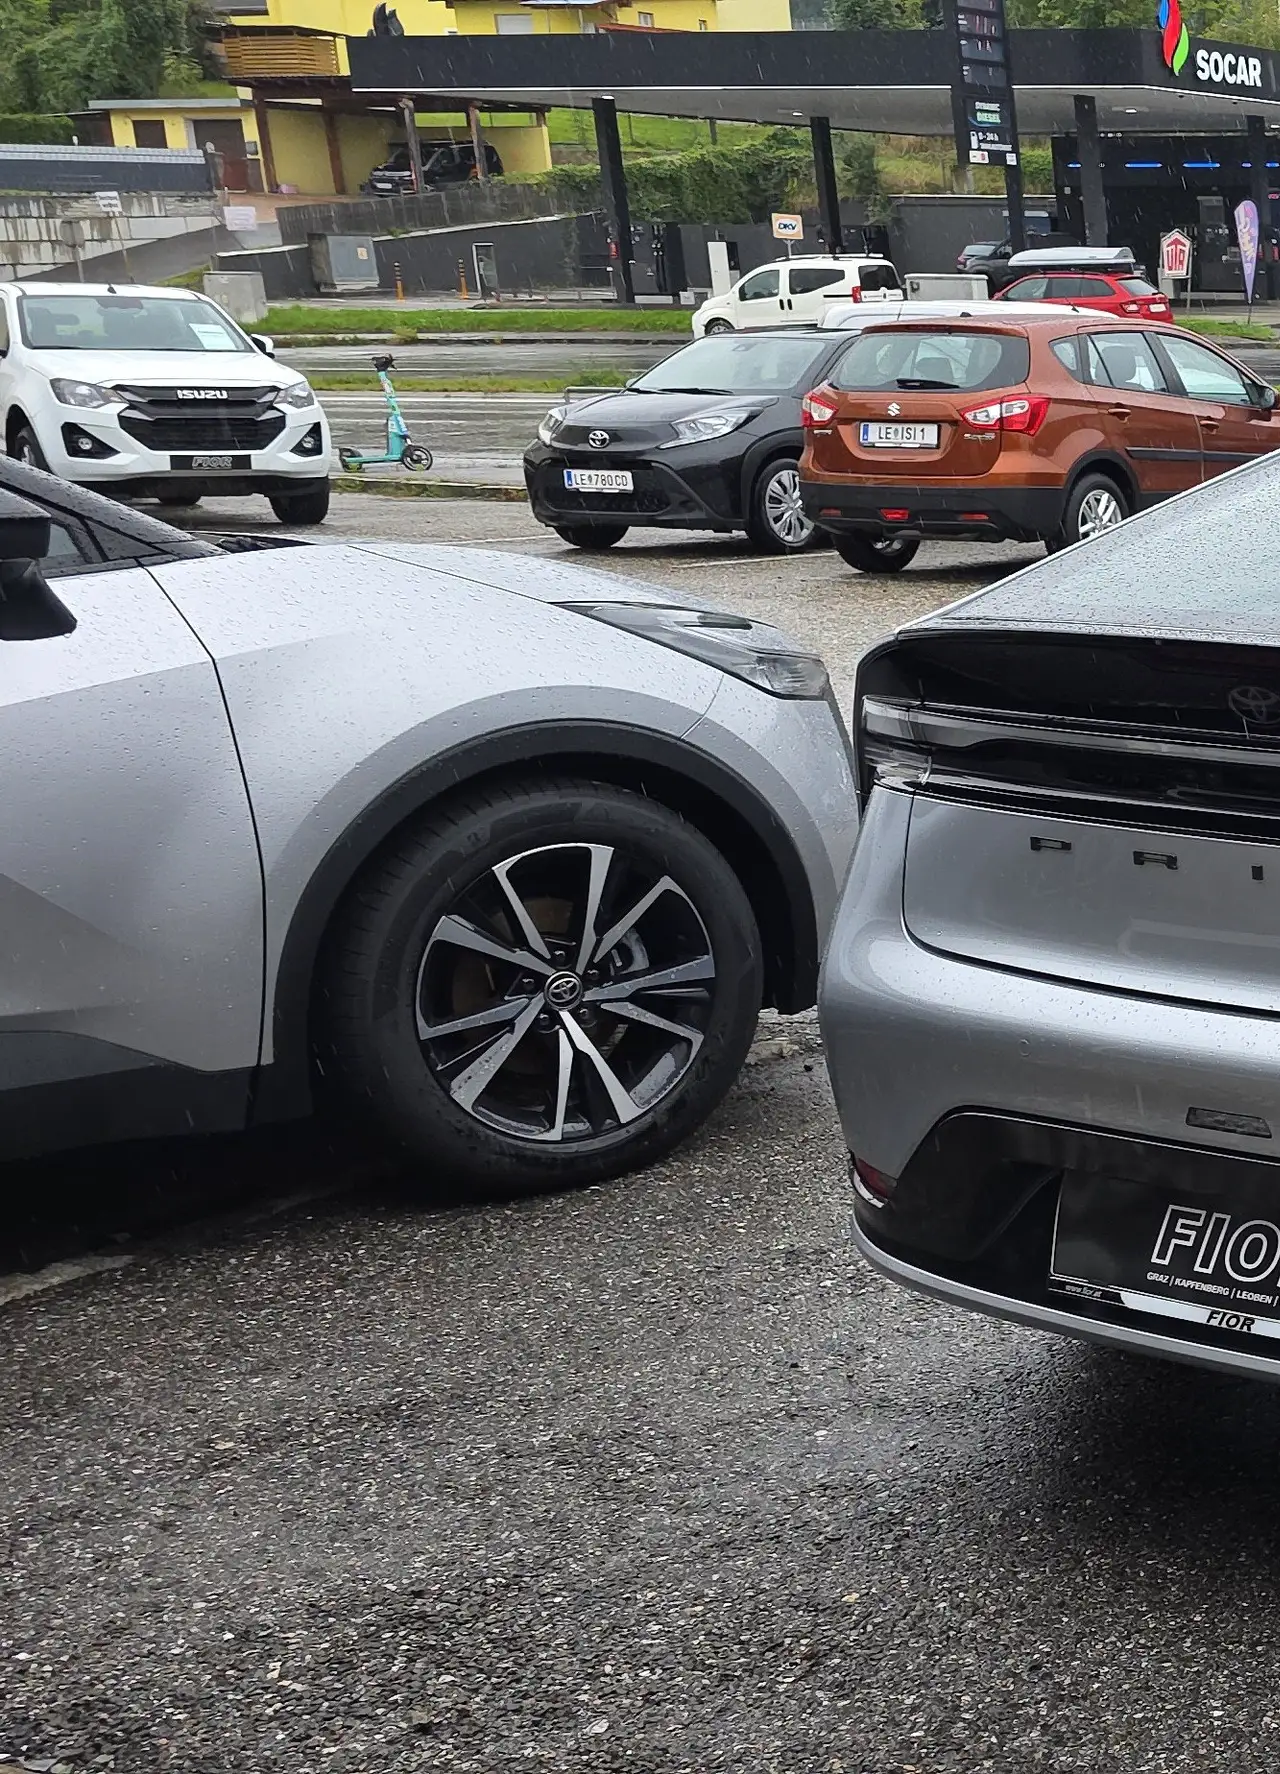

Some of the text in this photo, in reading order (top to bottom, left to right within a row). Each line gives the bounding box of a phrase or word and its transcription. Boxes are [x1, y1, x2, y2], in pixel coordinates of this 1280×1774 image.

[1196, 49, 1262, 87] SOCAR
[778, 222, 797, 230] DKV
[176, 389, 228, 399] ISUZU
[878, 427, 892, 440] LE
[900, 428, 917, 441] ISI
[191, 456, 233, 468] FIOR
[574, 473, 587, 486] LE
[1146, 1271, 1170, 1284] GRAZ
[1174, 1277, 1230, 1296] KAPFENBERG
[1236, 1288, 1273, 1305] LEOBEN
[1206, 1310, 1256, 1333] FIOR
